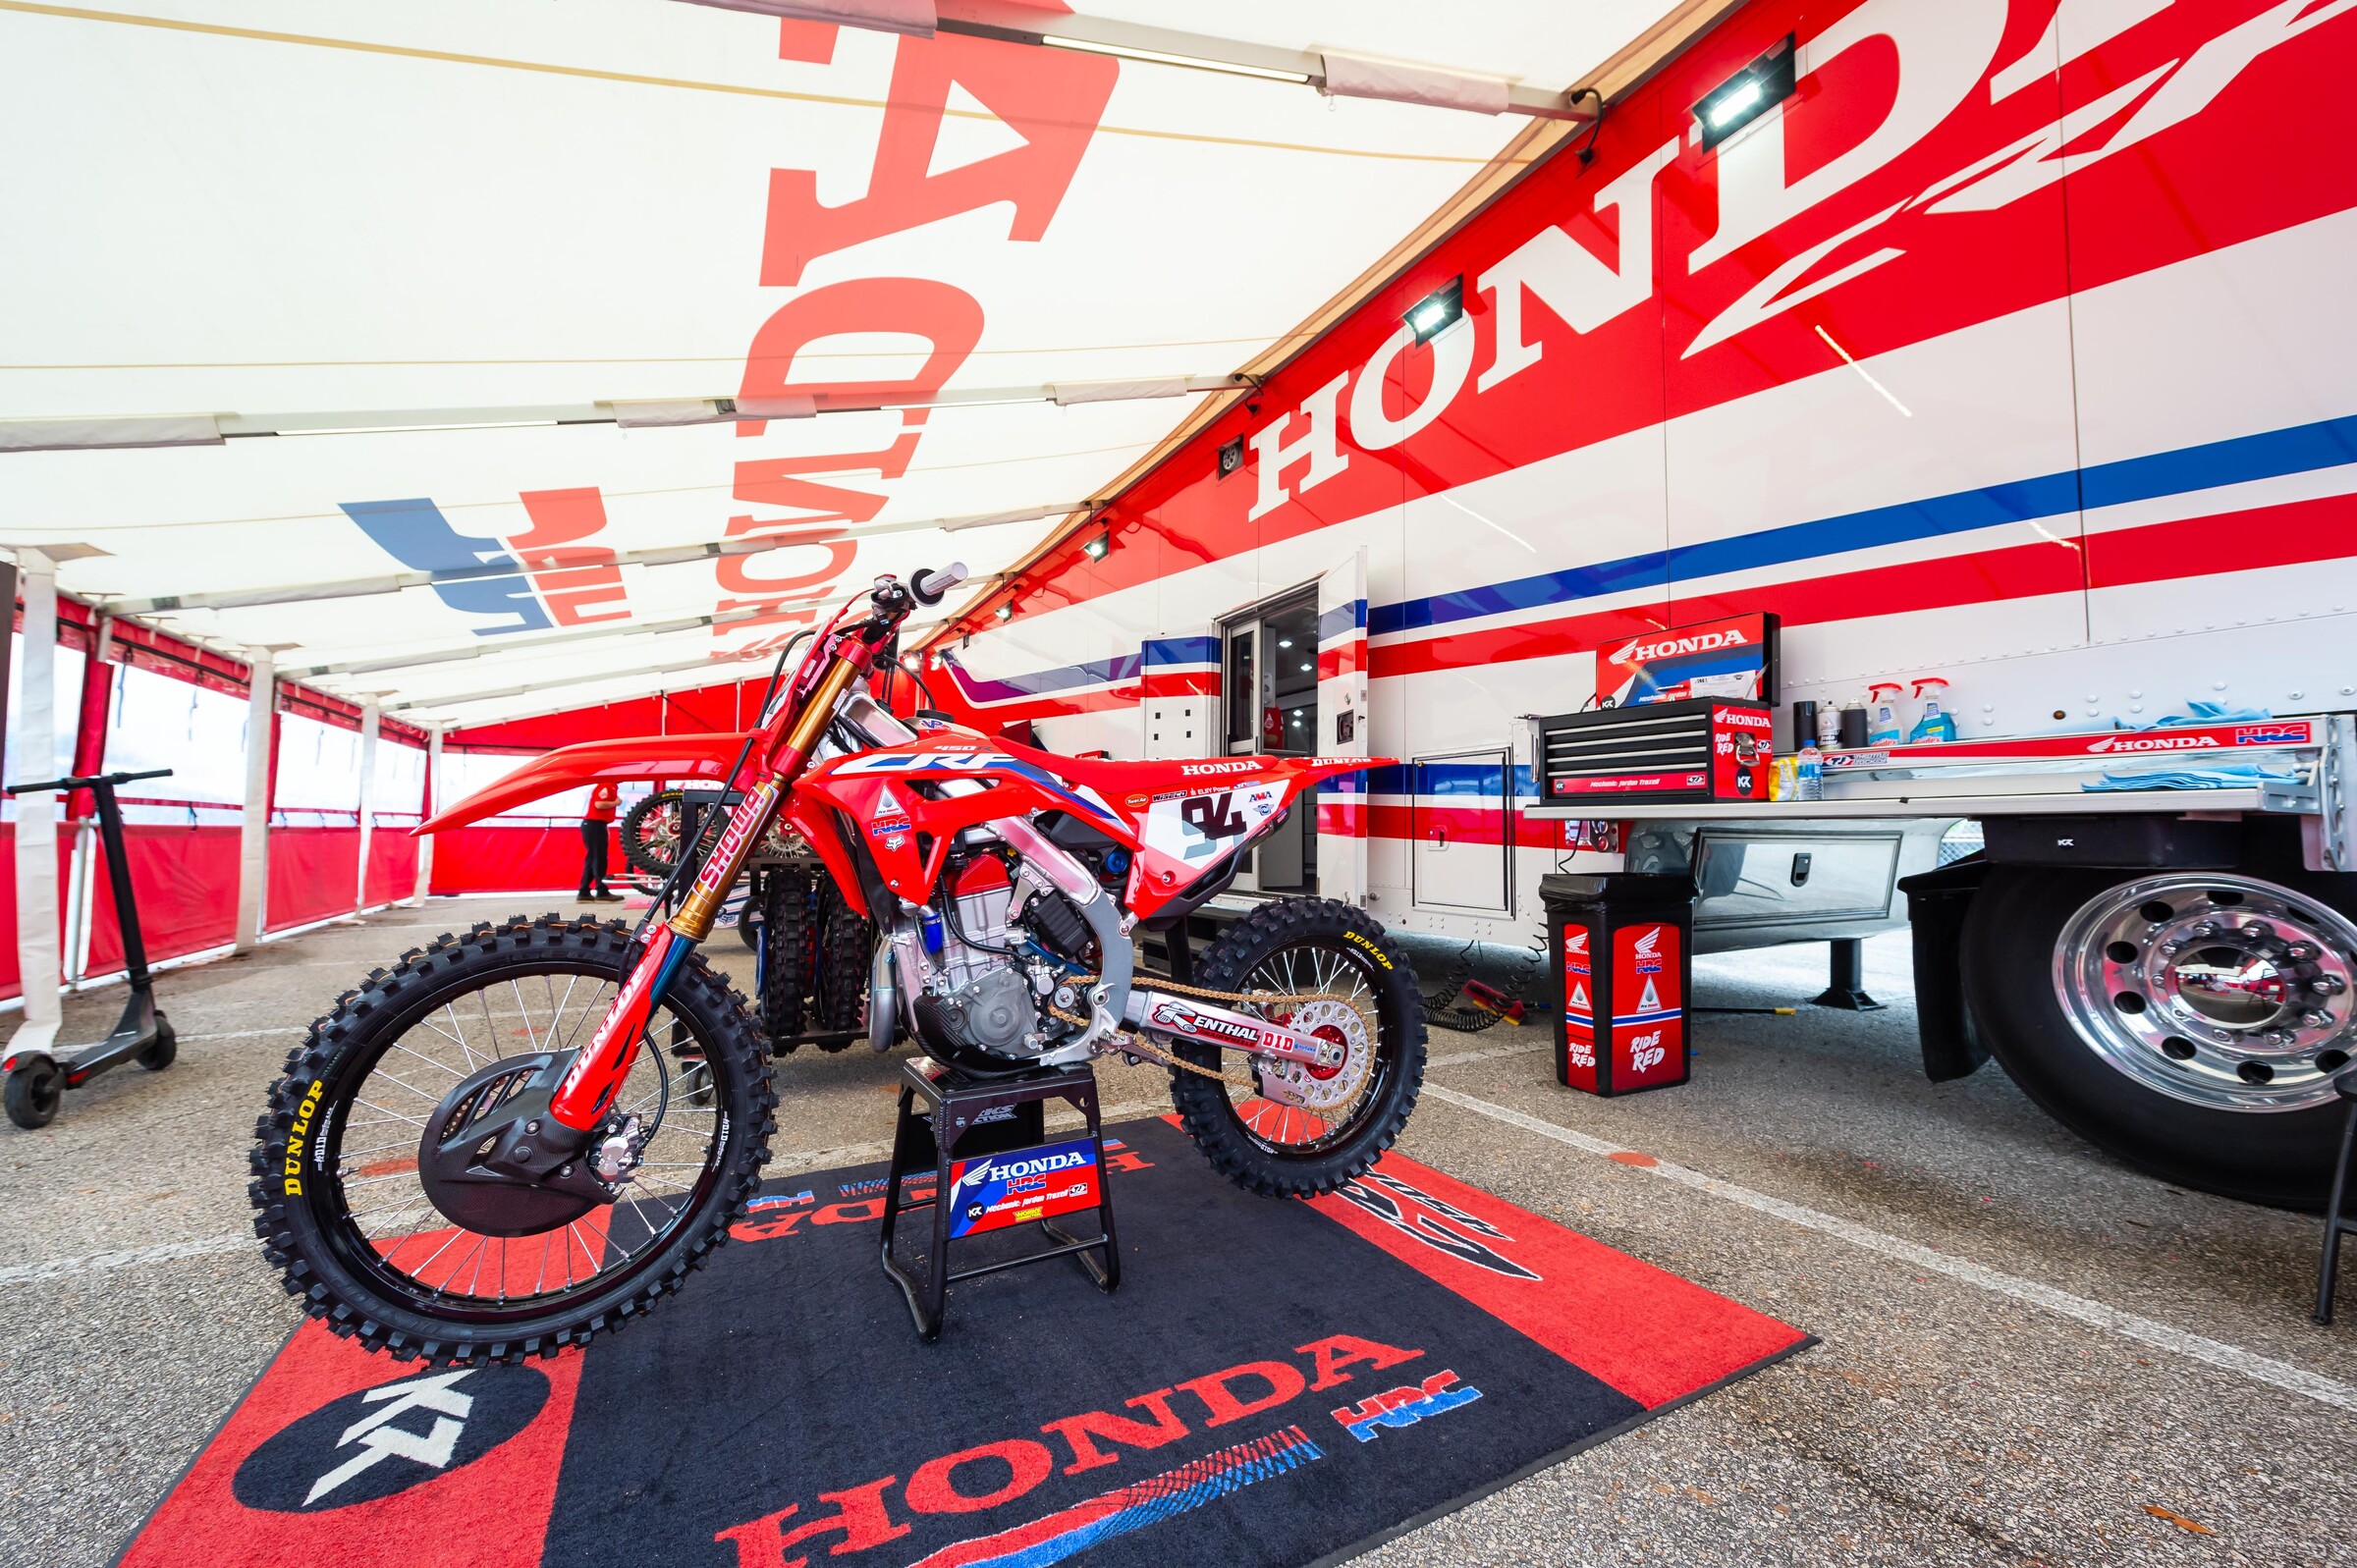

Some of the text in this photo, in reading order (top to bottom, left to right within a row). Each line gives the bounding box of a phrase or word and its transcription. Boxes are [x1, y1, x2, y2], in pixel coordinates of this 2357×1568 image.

[1634, 629, 1748, 661] HONDA
[1727, 714, 1772, 728] HONDA
[1715, 732, 1731, 743] RIDE
[1717, 742, 1734, 756] RED
[2112, 735, 2220, 753] HONDA
[829, 753, 1017, 775] CRF
[1180, 760, 1263, 776] HONDA
[1311, 758, 1372, 767] DUNLOP
[1249, 791, 1273, 802] AMA
[1181, 792, 1247, 860] 94
[699, 786, 765, 892] SHOWA
[1343, 931, 1394, 970] DUNLOP
[563, 964, 646, 1099] DUNLOP
[1630, 1030, 1662, 1054] RIDE
[1569, 1043, 1592, 1054] RIDE
[1632, 1047, 1666, 1073] RED
[1572, 1054, 1596, 1067] RED
[284, 1080, 323, 1196] DUNLOP
[989, 1151, 1086, 1182] HONDA
[715, 1333, 1425, 1568] HONDA
